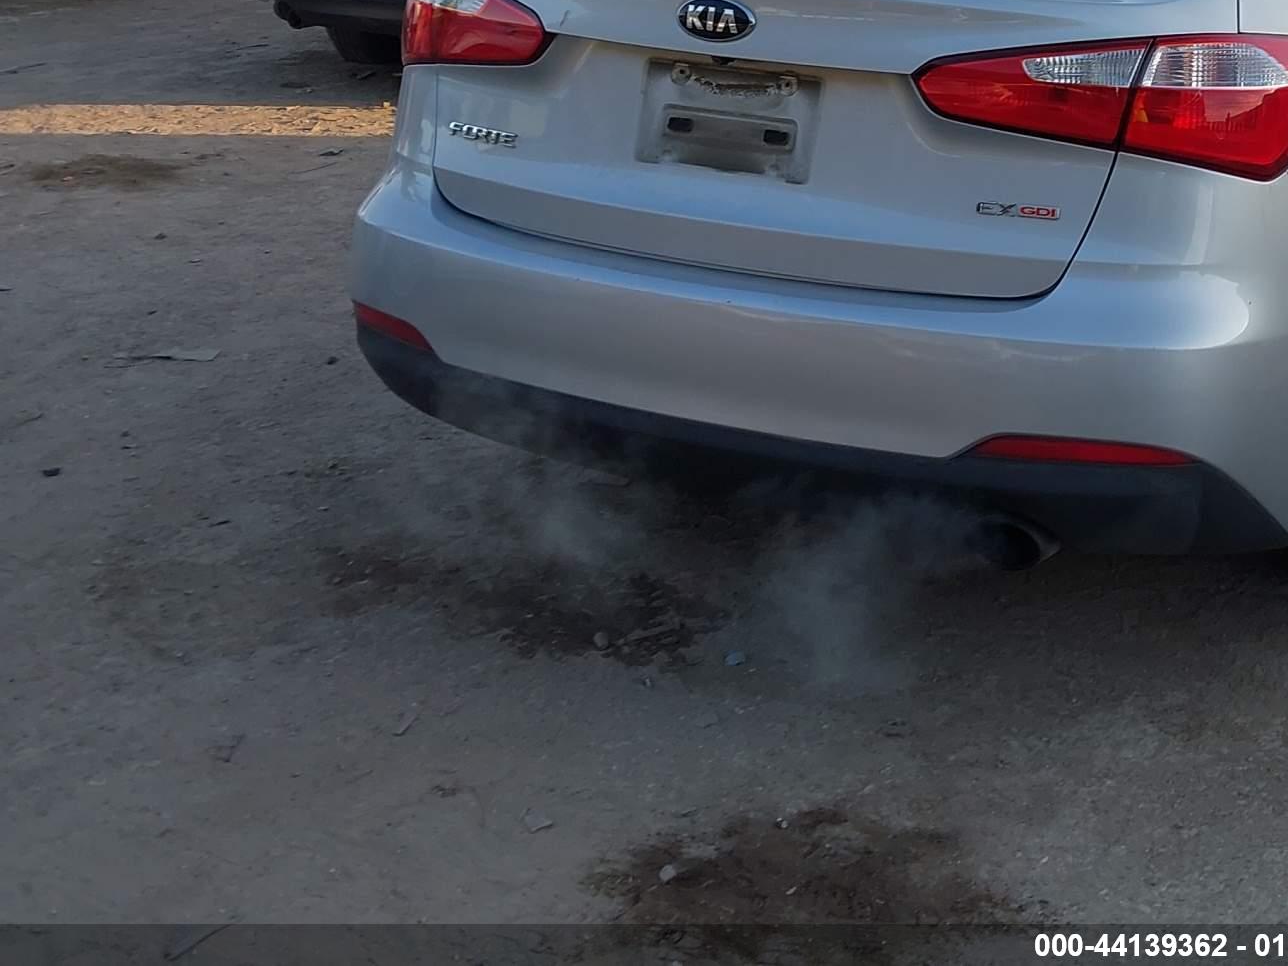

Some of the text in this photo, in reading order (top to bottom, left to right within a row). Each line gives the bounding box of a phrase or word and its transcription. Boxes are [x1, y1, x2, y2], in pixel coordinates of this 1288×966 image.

[686, 4, 738, 34] KIA
[448, 121, 518, 148] FORTE
[976, 201, 1057, 218] EX GDI
